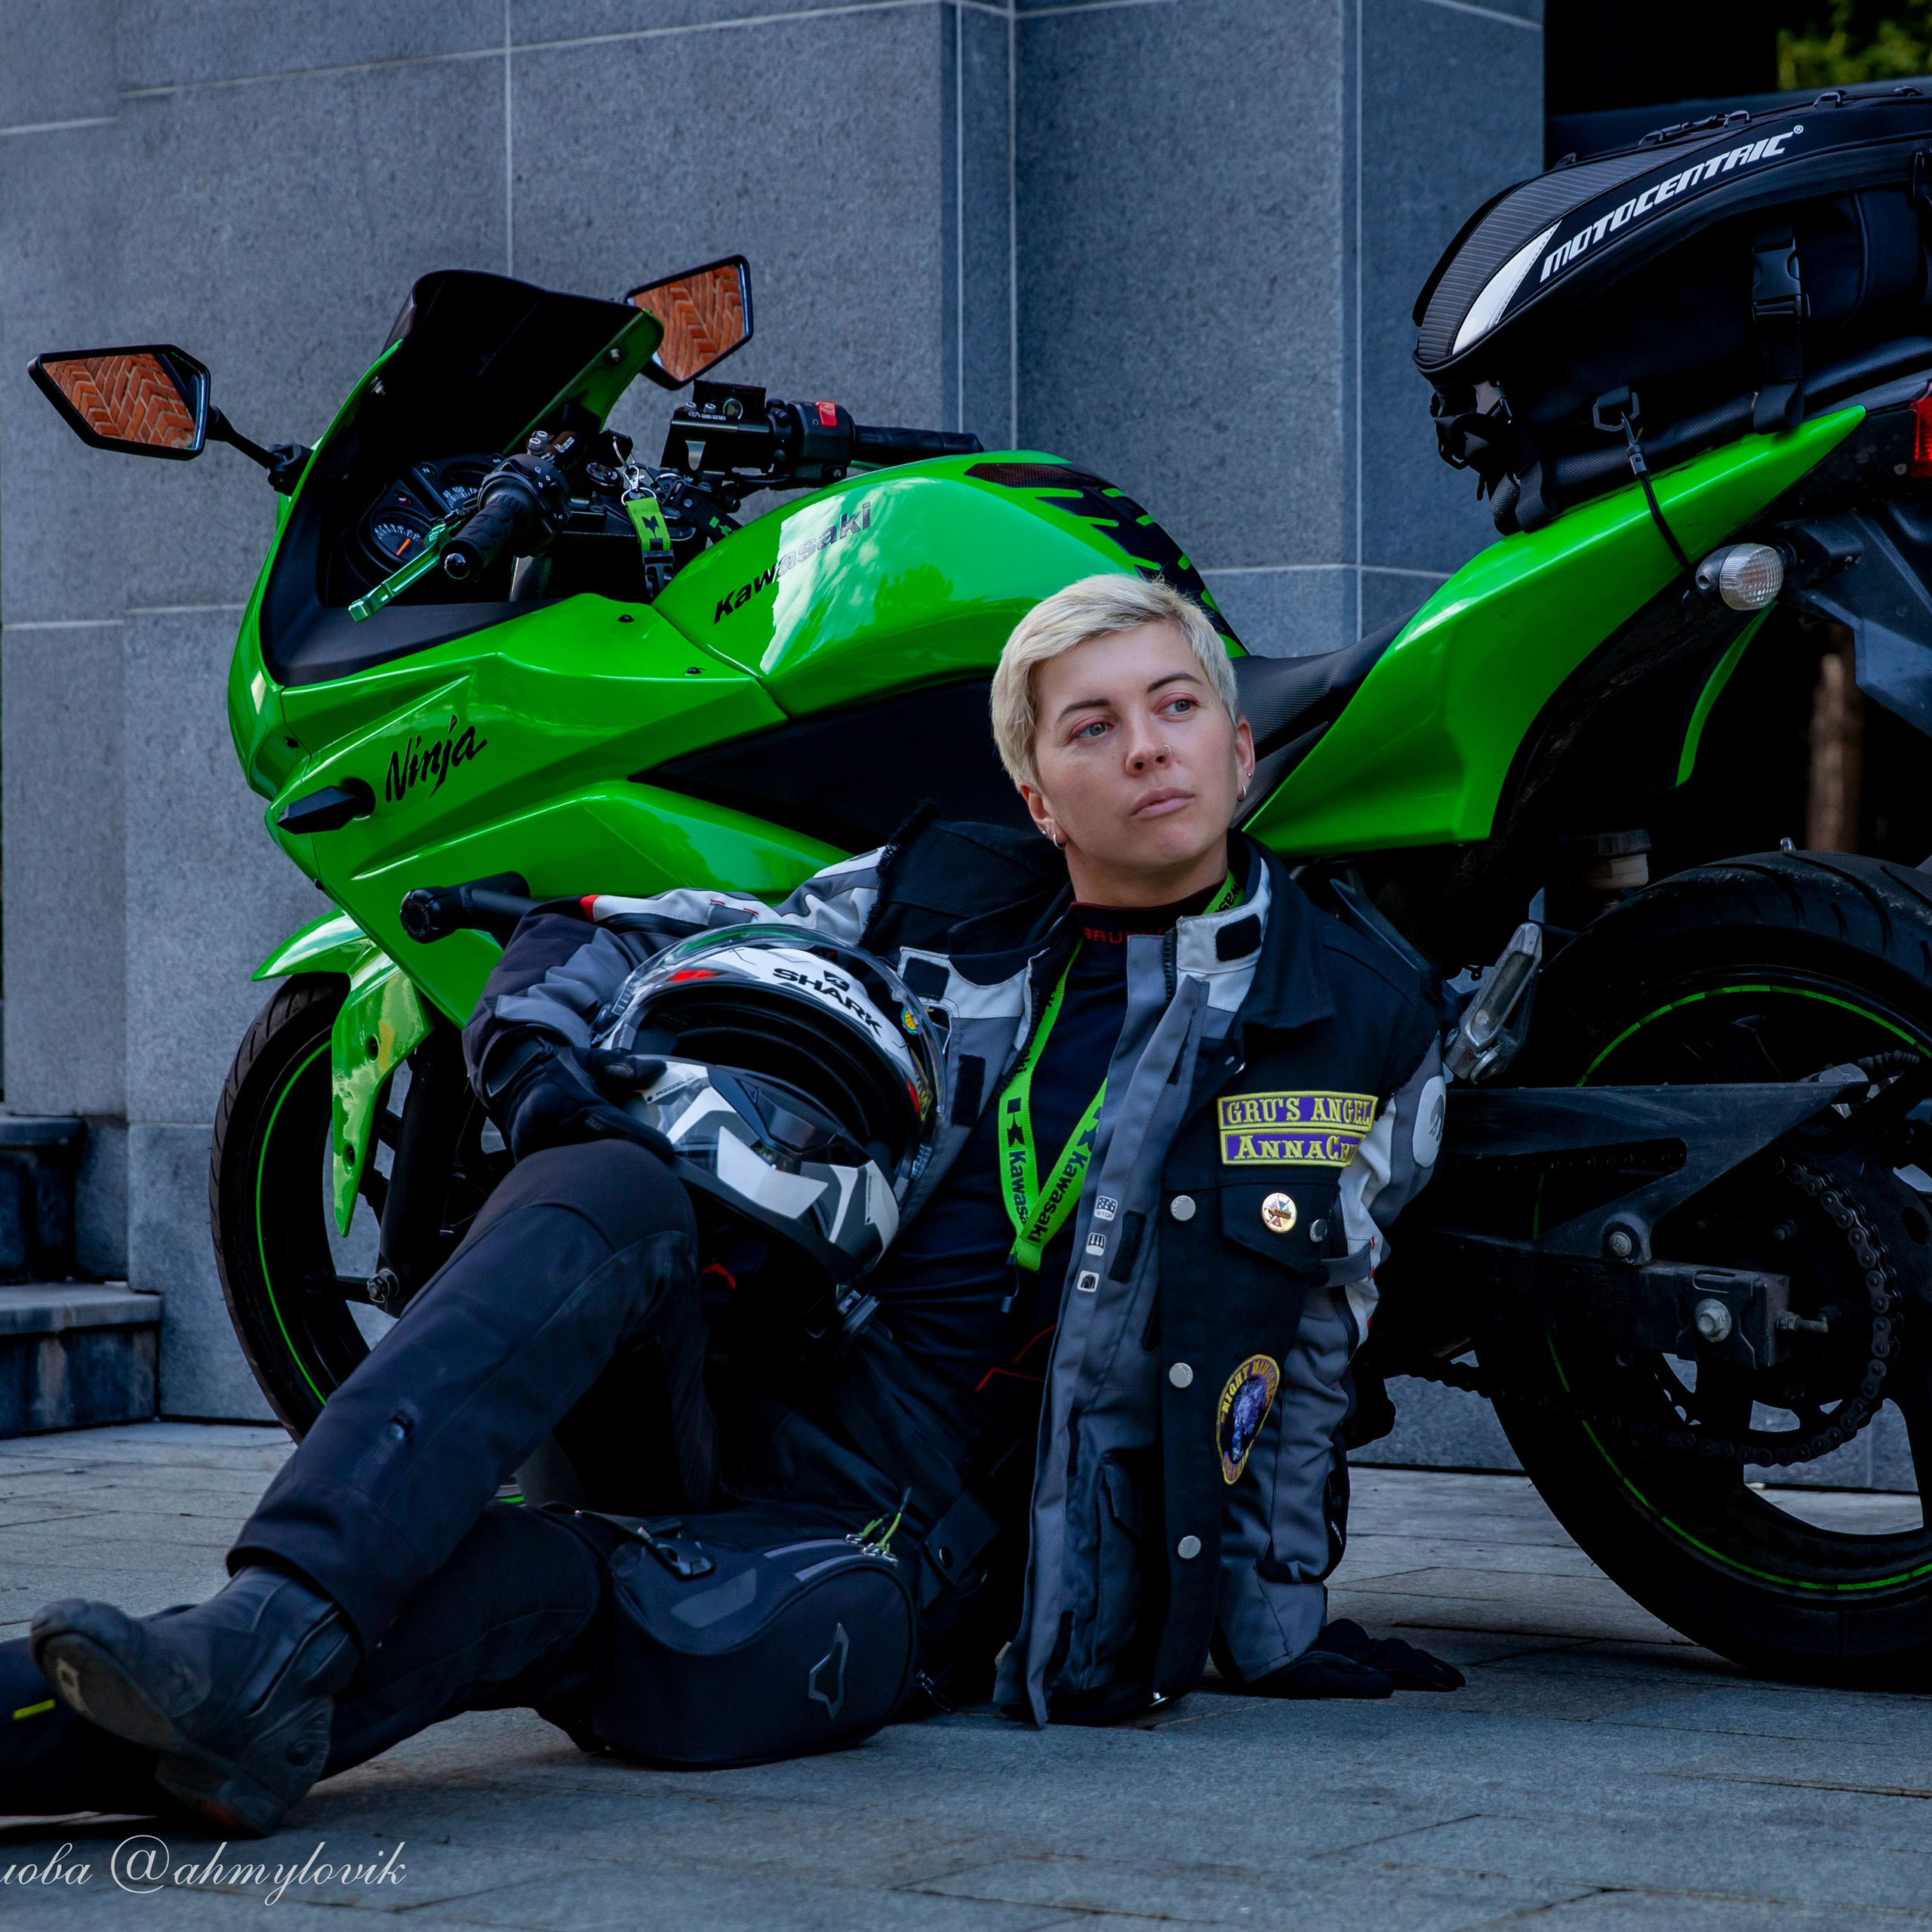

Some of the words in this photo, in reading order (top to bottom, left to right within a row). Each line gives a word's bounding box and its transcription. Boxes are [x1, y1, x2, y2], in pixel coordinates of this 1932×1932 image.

[713, 501, 872, 624] Kawasaki
[385, 715, 488, 802] Ninja
[773, 968, 883, 1037] SHARK
[1226, 1097, 1301, 1124] GRU'S
[1310, 1097, 1371, 1127] ANGEL
[1026, 1151, 1089, 1244] Kawasaki
[1096, 1210, 1114, 1220] STOP
